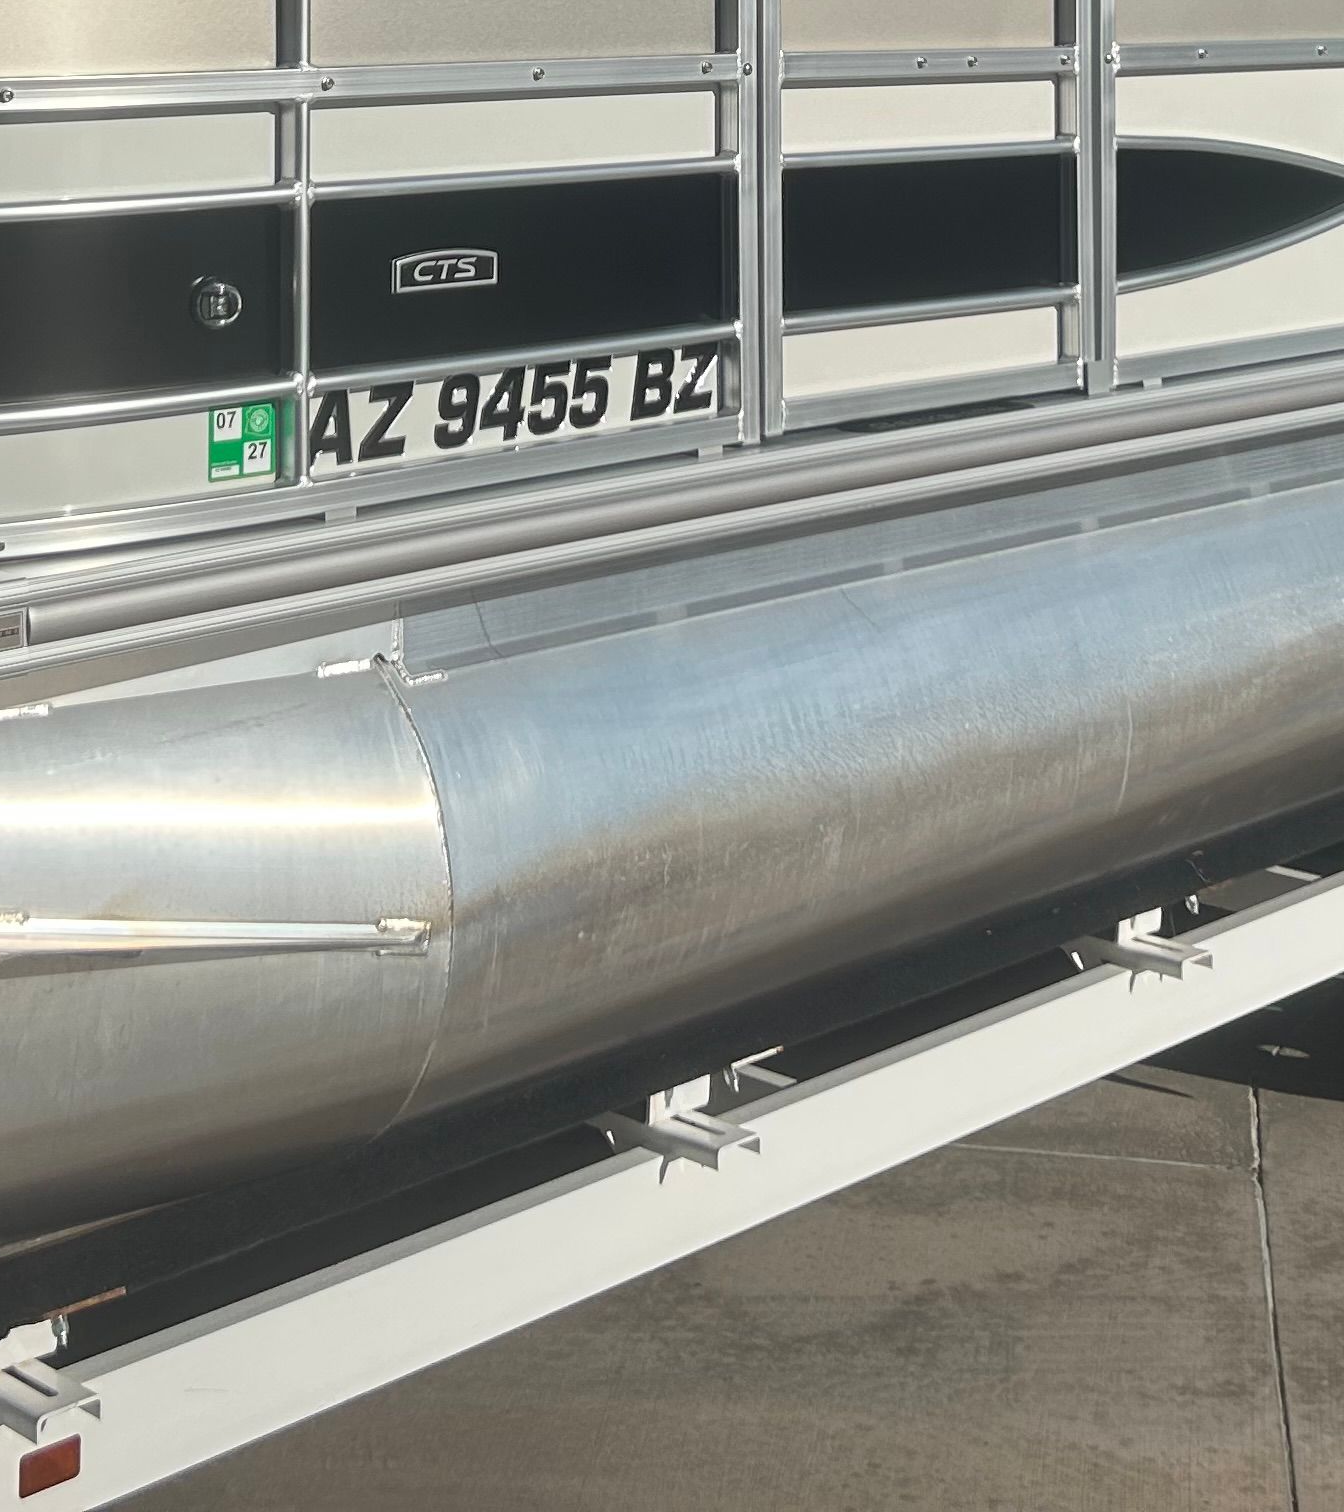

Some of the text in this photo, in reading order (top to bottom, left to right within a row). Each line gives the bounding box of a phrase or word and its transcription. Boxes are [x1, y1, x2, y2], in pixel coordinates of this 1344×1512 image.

[414, 257, 477, 281] CTS
[310, 342, 718, 465] AZ 9455 BZ
[216, 411, 236, 429] 07
[248, 442, 267, 460] 27
